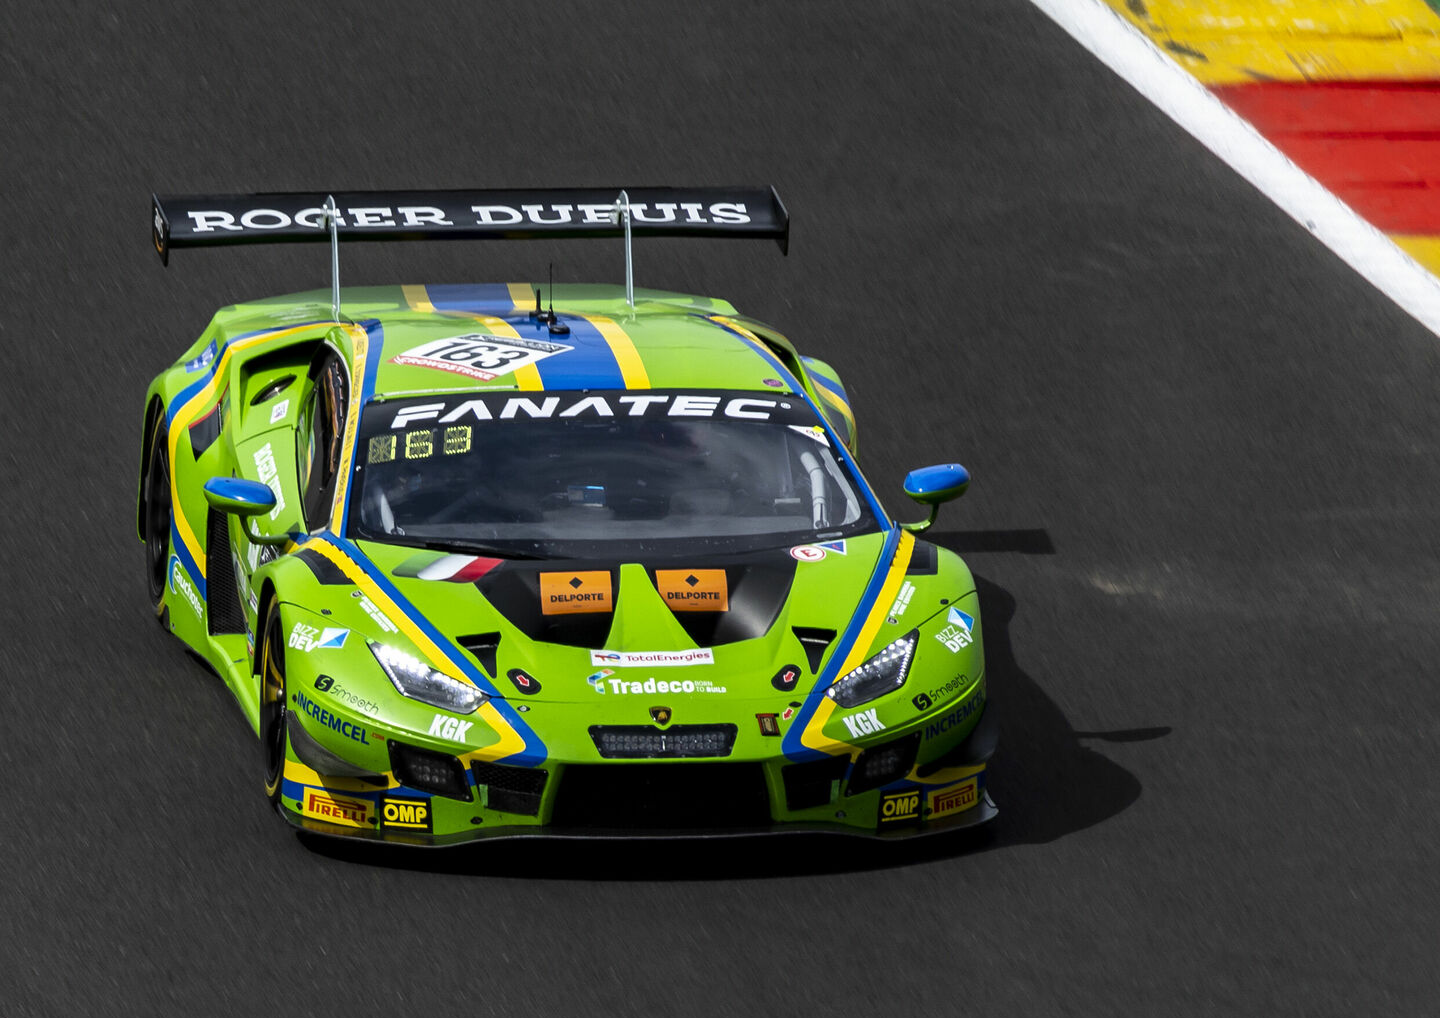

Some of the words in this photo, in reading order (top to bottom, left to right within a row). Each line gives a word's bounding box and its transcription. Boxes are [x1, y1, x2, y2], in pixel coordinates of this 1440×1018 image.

[422, 341, 530, 369] 163
[397, 356, 497, 381] CROWDSTRIKE
[391, 396, 777, 429] FANATEC
[550, 593, 604, 603] DELPORTE
[667, 591, 720, 600] DELPORTE
[293, 622, 319, 638] BIZZ
[934, 624, 959, 643] BIZZ
[944, 629, 974, 654] DEV
[288, 632, 320, 653] DEV
[625, 652, 711, 662] TotalEnergies
[608, 678, 695, 694] Tradeco
[297, 690, 370, 746] INCREMCEL
[428, 713, 474, 744] KGK
[842, 708, 887, 739] KGK
[308, 793, 368, 823] PIRELLI
[882, 796, 919, 816] OMP
[933, 784, 975, 814] PIRELLI
[383, 803, 428, 824] OMP
